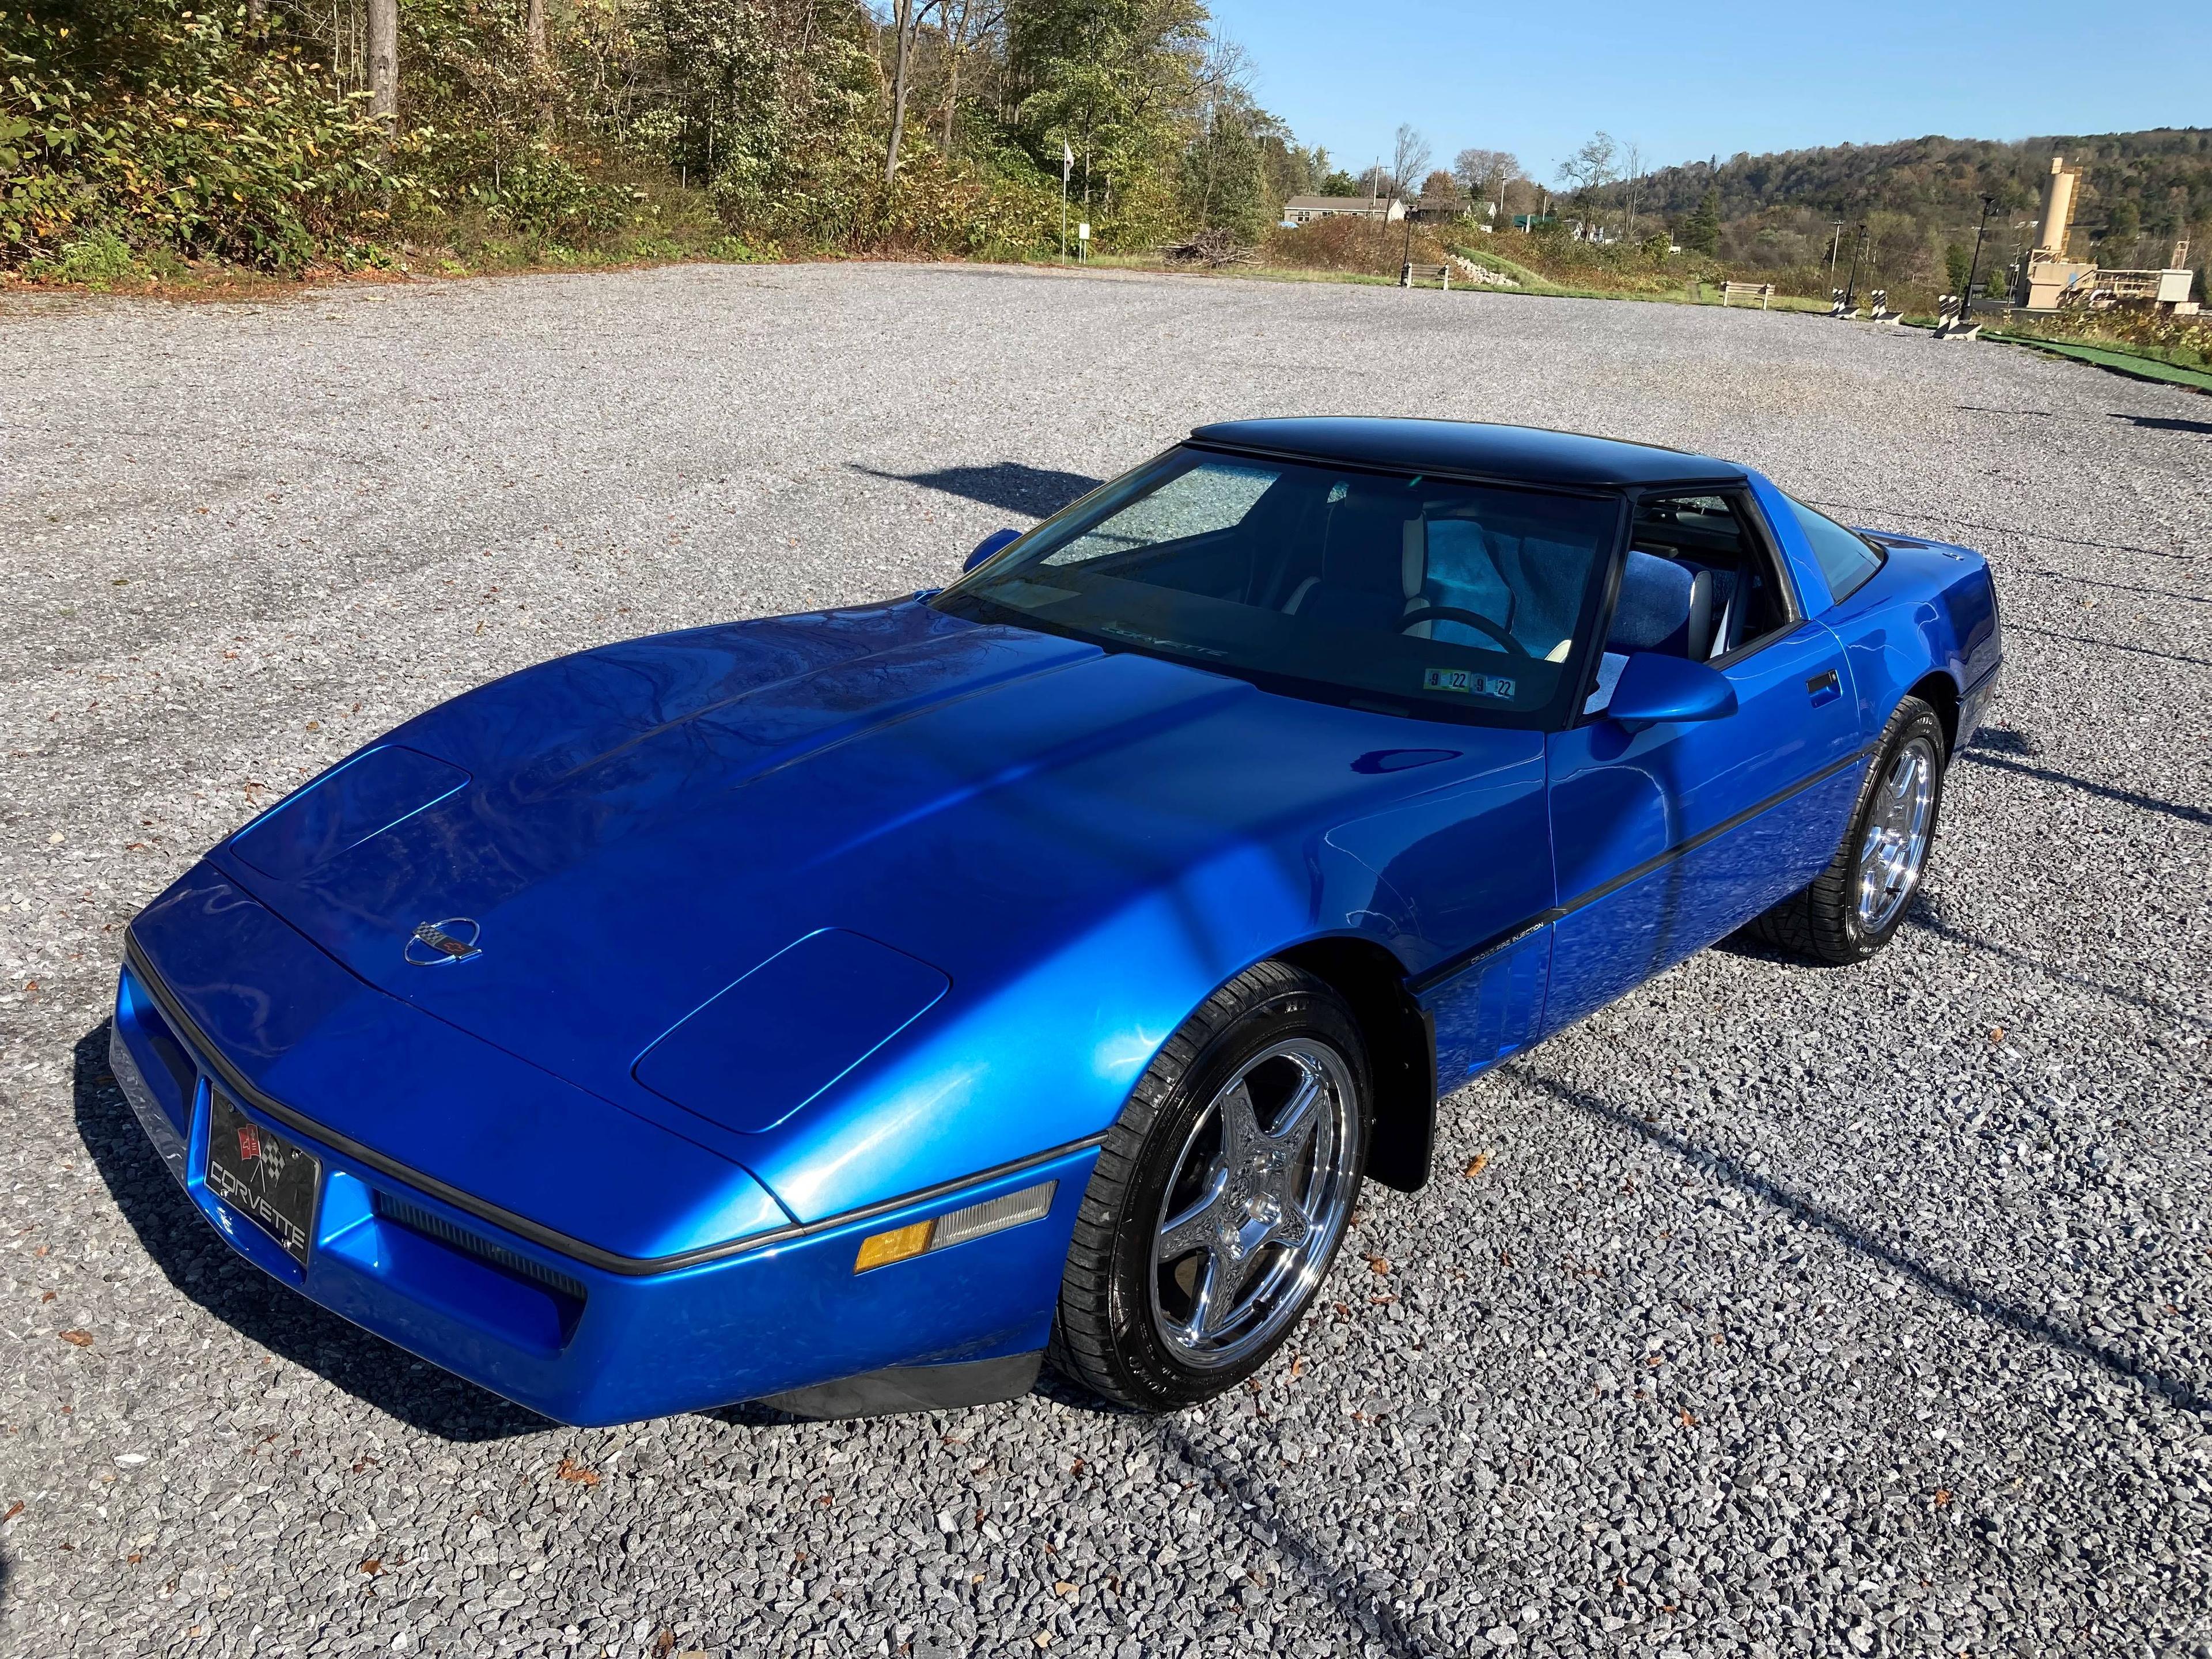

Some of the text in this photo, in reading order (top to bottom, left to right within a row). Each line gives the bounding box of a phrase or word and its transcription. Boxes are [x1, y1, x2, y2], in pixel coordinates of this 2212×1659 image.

[1431, 672, 1466, 688] 9 22
[1476, 679, 1511, 696] 9 22
[1512, 922, 1544, 942] INJECTION
[211, 1160, 306, 1250] CORVETTE
